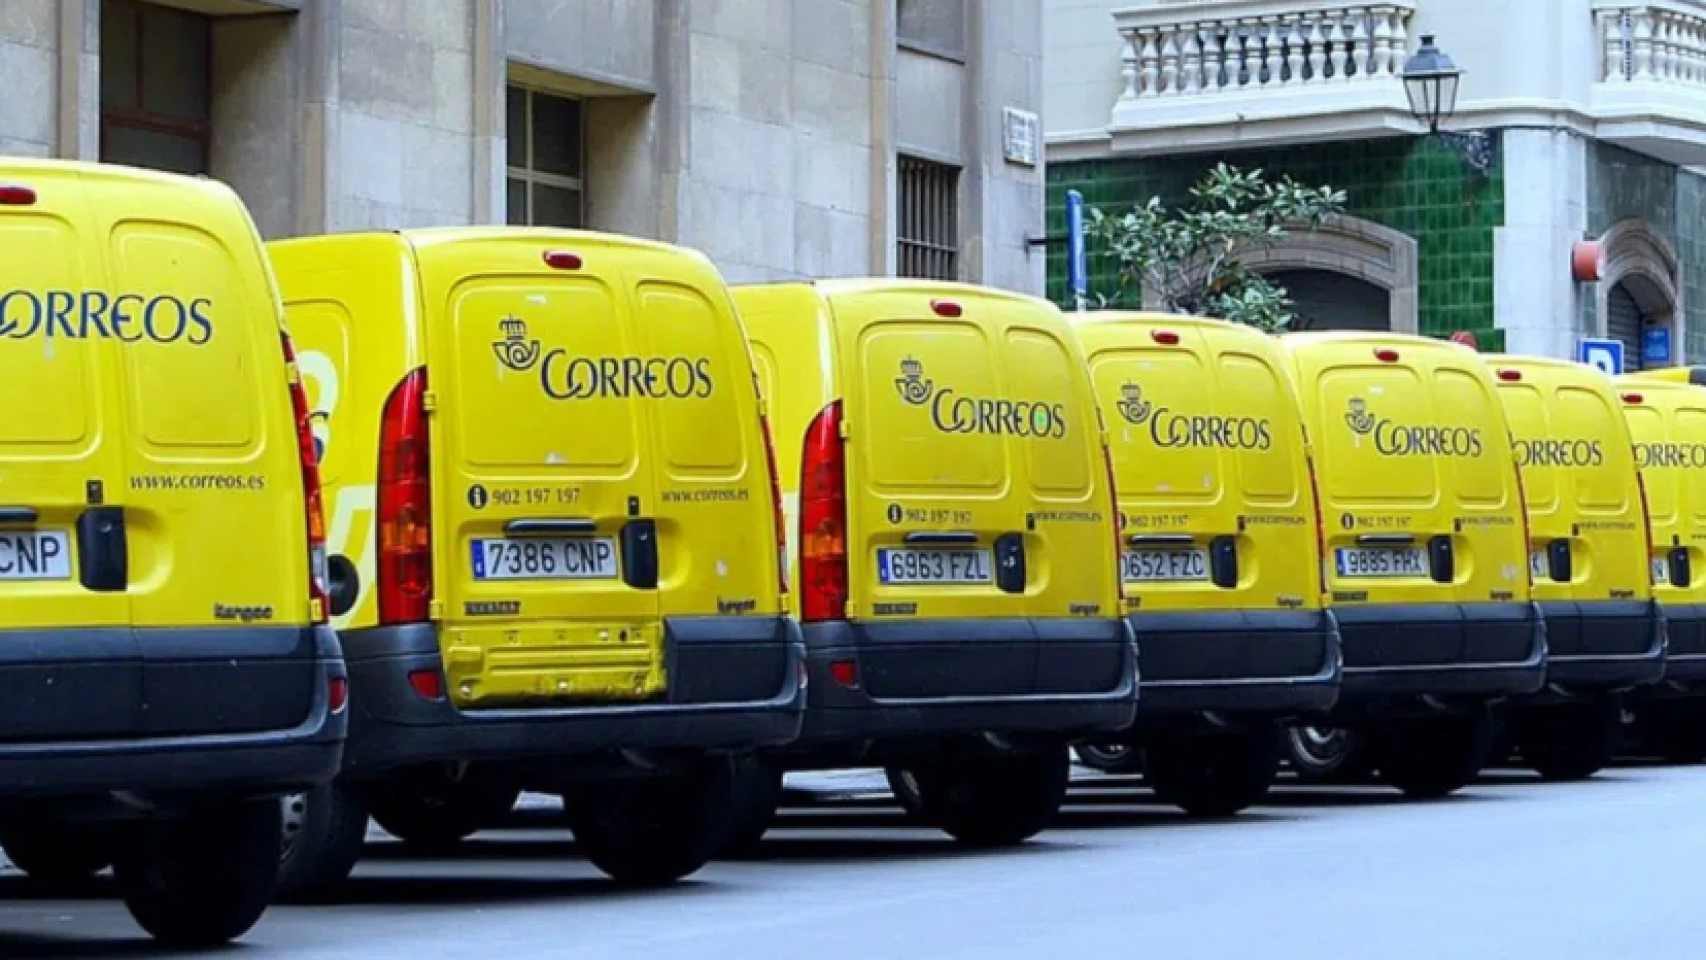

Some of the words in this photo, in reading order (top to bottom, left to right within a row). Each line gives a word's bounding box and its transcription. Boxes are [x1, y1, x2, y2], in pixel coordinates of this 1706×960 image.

[0, 290, 212, 345] ORREOS
[541, 349, 713, 399] CORREOS
[932, 388, 1066, 439] CORREOS
[1151, 407, 1271, 451] CORREOS
[1374, 420, 1482, 457] CORREOS
[1513, 440, 1602, 466] ORREOS
[1634, 444, 1706, 468] ORREO
[130, 474, 264, 490] www.correos.es
[492, 488, 521, 505] 902
[526, 488, 550, 504] 197
[557, 487, 580, 503] 197
[0, 537, 60, 574] CNP
[489, 542, 556, 575] 7386
[564, 542, 610, 573] CNP
[891, 551, 944, 579] 6963
[950, 551, 988, 579] FZL
